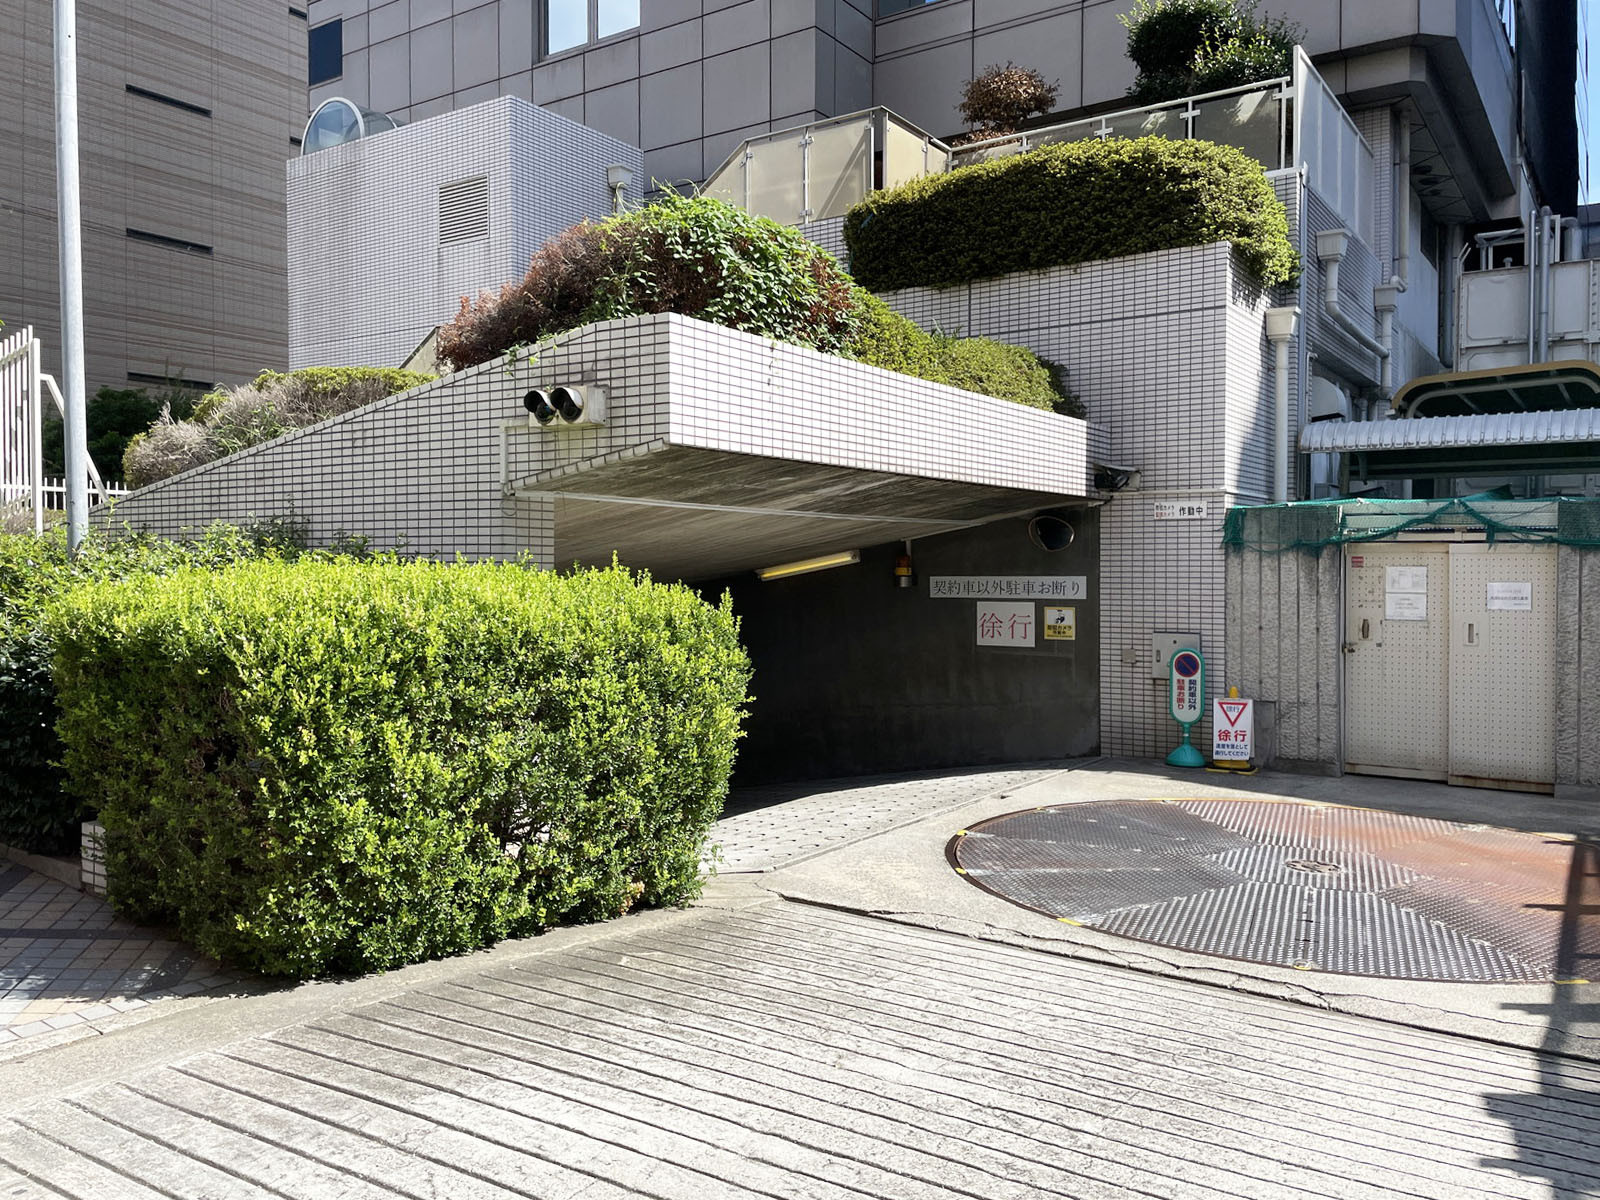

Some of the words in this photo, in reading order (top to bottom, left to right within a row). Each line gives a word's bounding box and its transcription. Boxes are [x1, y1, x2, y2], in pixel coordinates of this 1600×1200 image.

[1179, 506, 1203, 516] 作動中
[933, 580, 1080, 596] 契約車以外駐車お断り
[979, 612, 1032, 639] 徐行
[1218, 730, 1247, 742] 徐行
